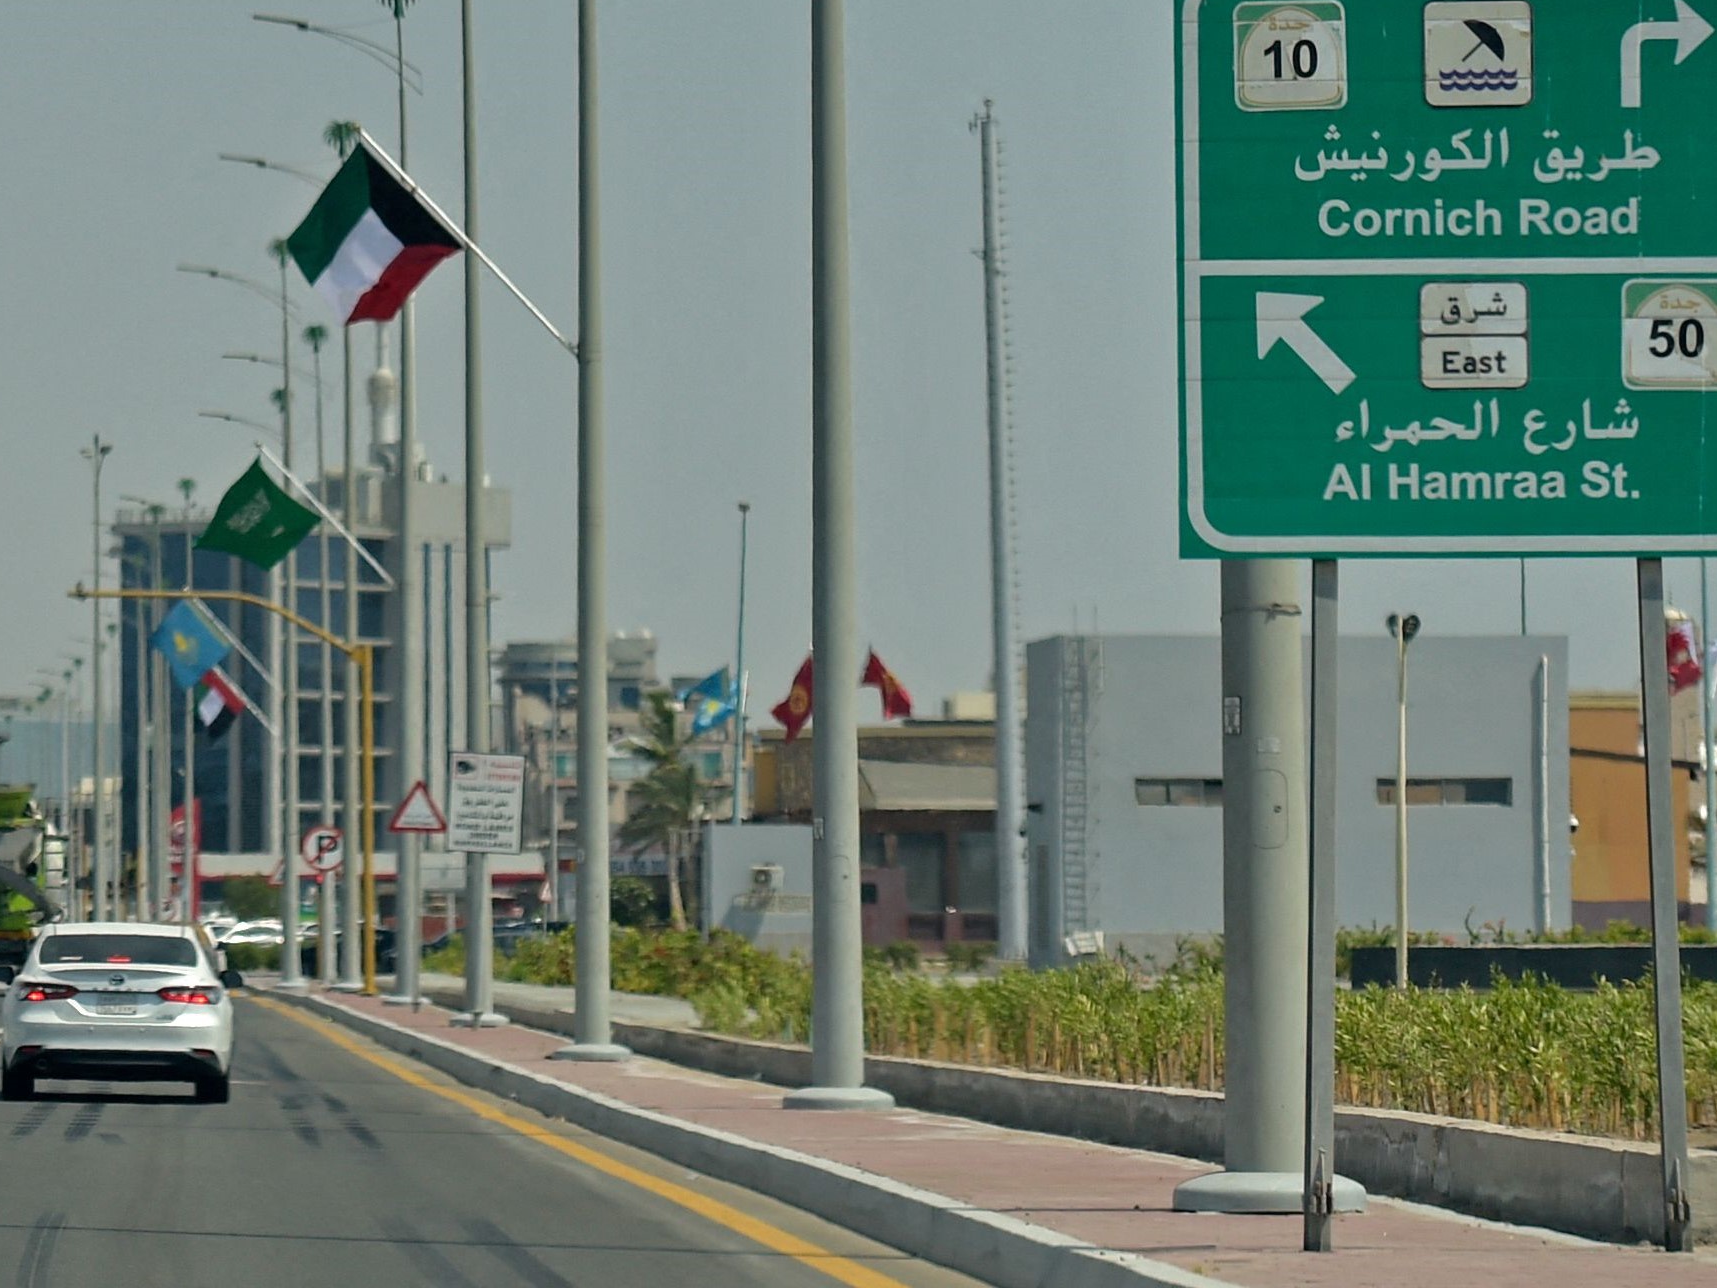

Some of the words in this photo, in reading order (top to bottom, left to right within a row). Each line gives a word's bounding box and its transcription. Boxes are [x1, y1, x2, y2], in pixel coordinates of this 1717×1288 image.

[1263, 39, 1319, 80] 10
[1295, 125, 1511, 182] الكورنيش
[1534, 128, 1661, 183] طريق
[1318, 199, 1503, 237] Cornich
[1520, 198, 1640, 236] Road
[1441, 292, 1508, 326] شرق
[1649, 318, 1706, 359] 50
[1442, 349, 1507, 375] East
[1336, 399, 1500, 453] الحمراء
[1523, 399, 1641, 455] شارع
[1323, 463, 1372, 501] Al
[1389, 463, 1568, 501] Hamraa
[1580, 461, 1642, 501] St.
